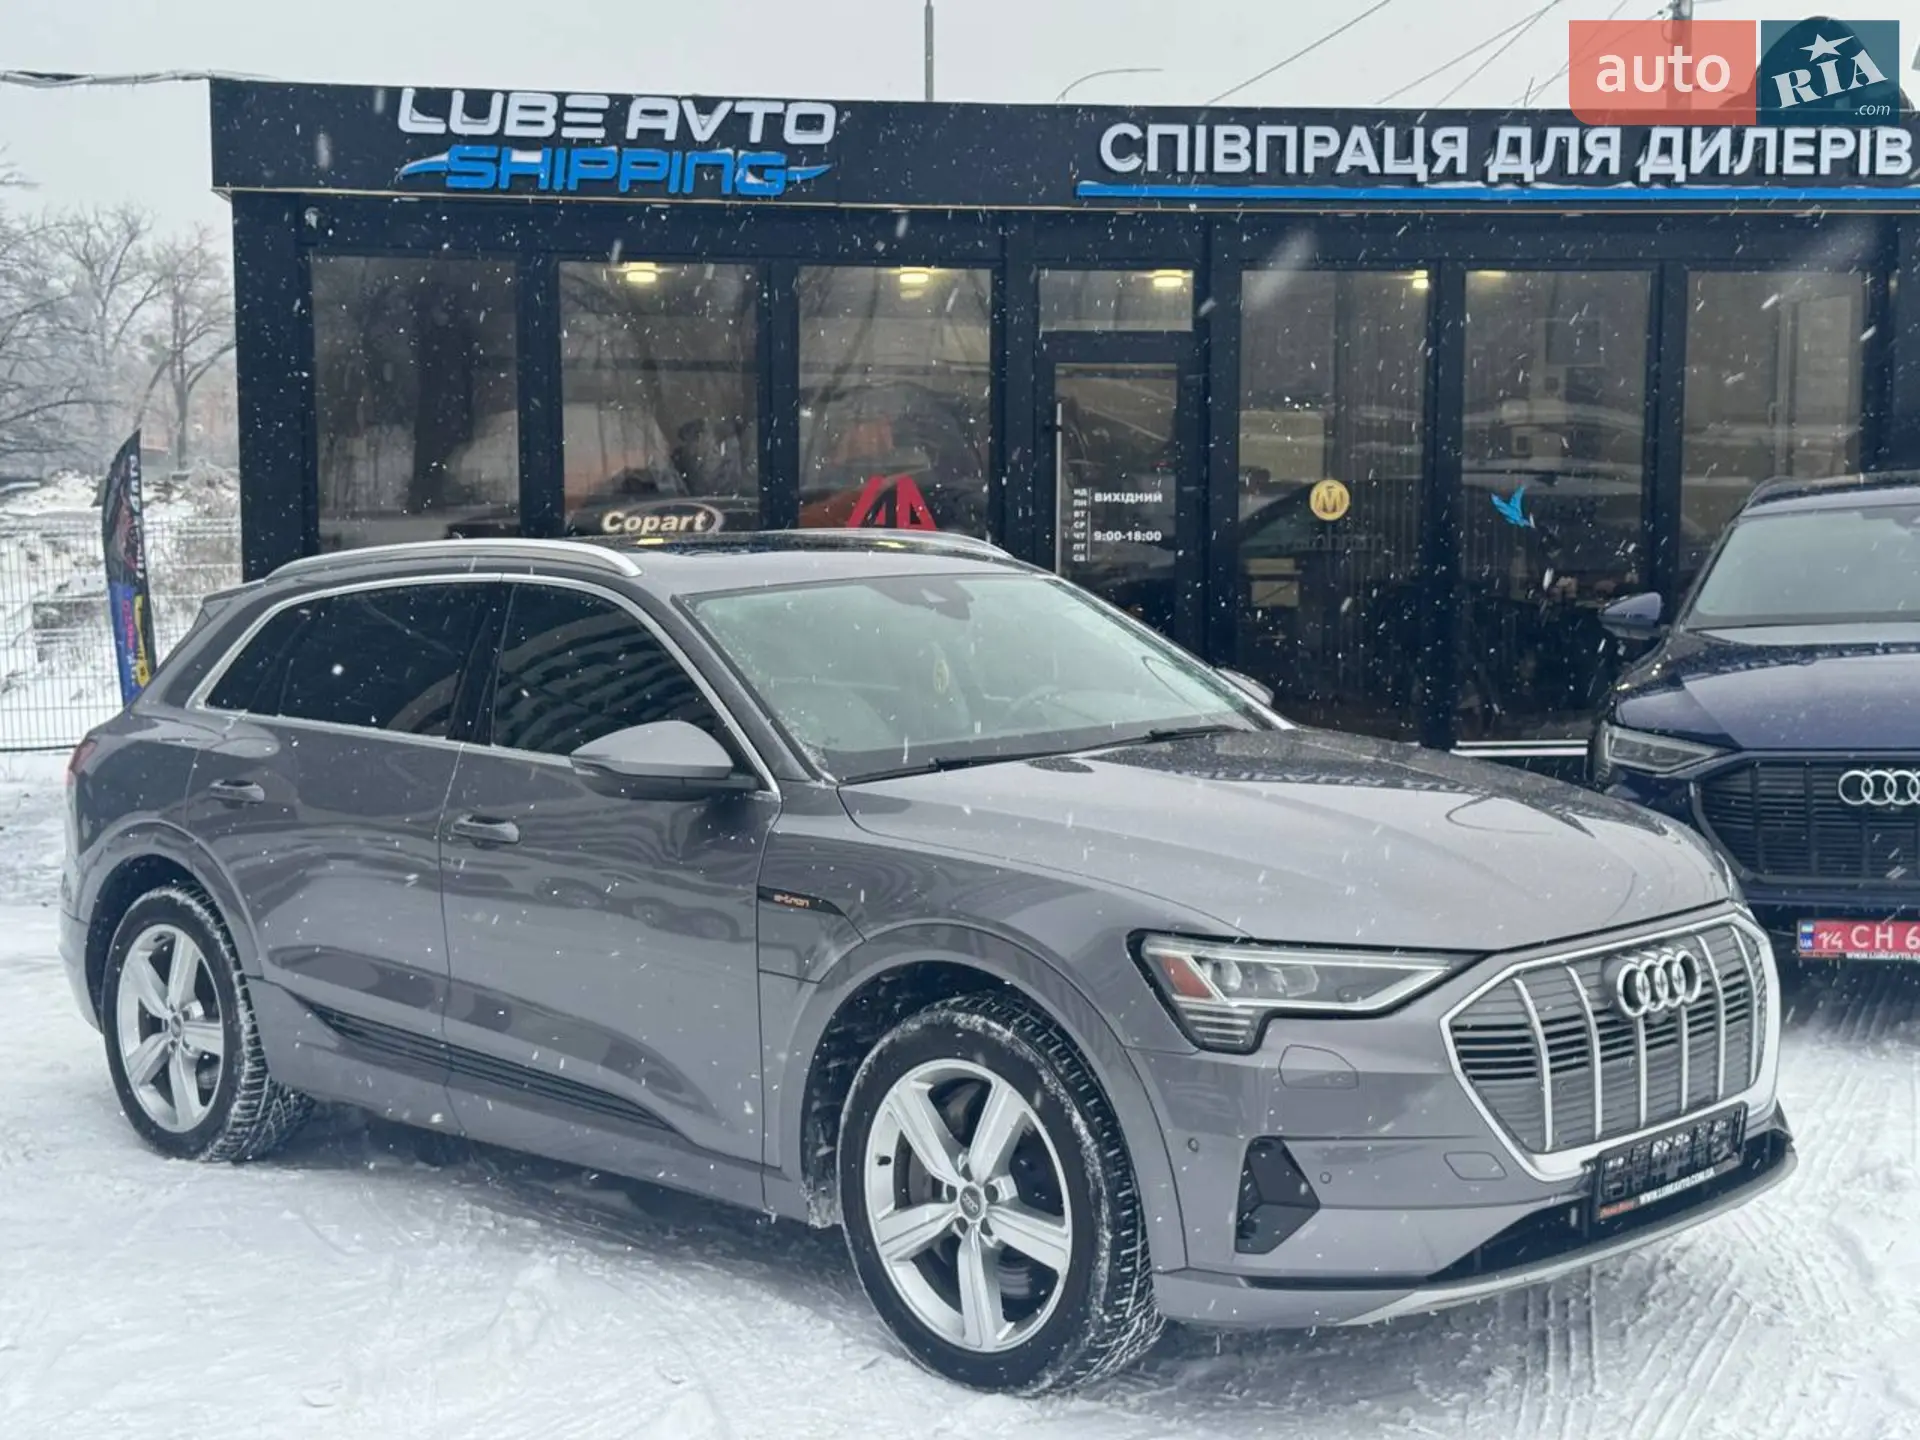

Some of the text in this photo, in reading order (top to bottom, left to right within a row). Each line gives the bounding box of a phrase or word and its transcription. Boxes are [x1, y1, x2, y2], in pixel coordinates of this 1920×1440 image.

[398, 87, 837, 145] LUBE AVTO
[1099, 122, 1913, 183] СПІВПРАЦЯ ДЛЯ ДИЛЕРІВ
[445, 143, 787, 196] SHIPPING
[1094, 492, 1162, 504] ВИХІДНИЙ
[602, 510, 706, 536] Copart
[1093, 531, 1162, 542] 9:00-18:00
[1850, 924, 1894, 949] CH
